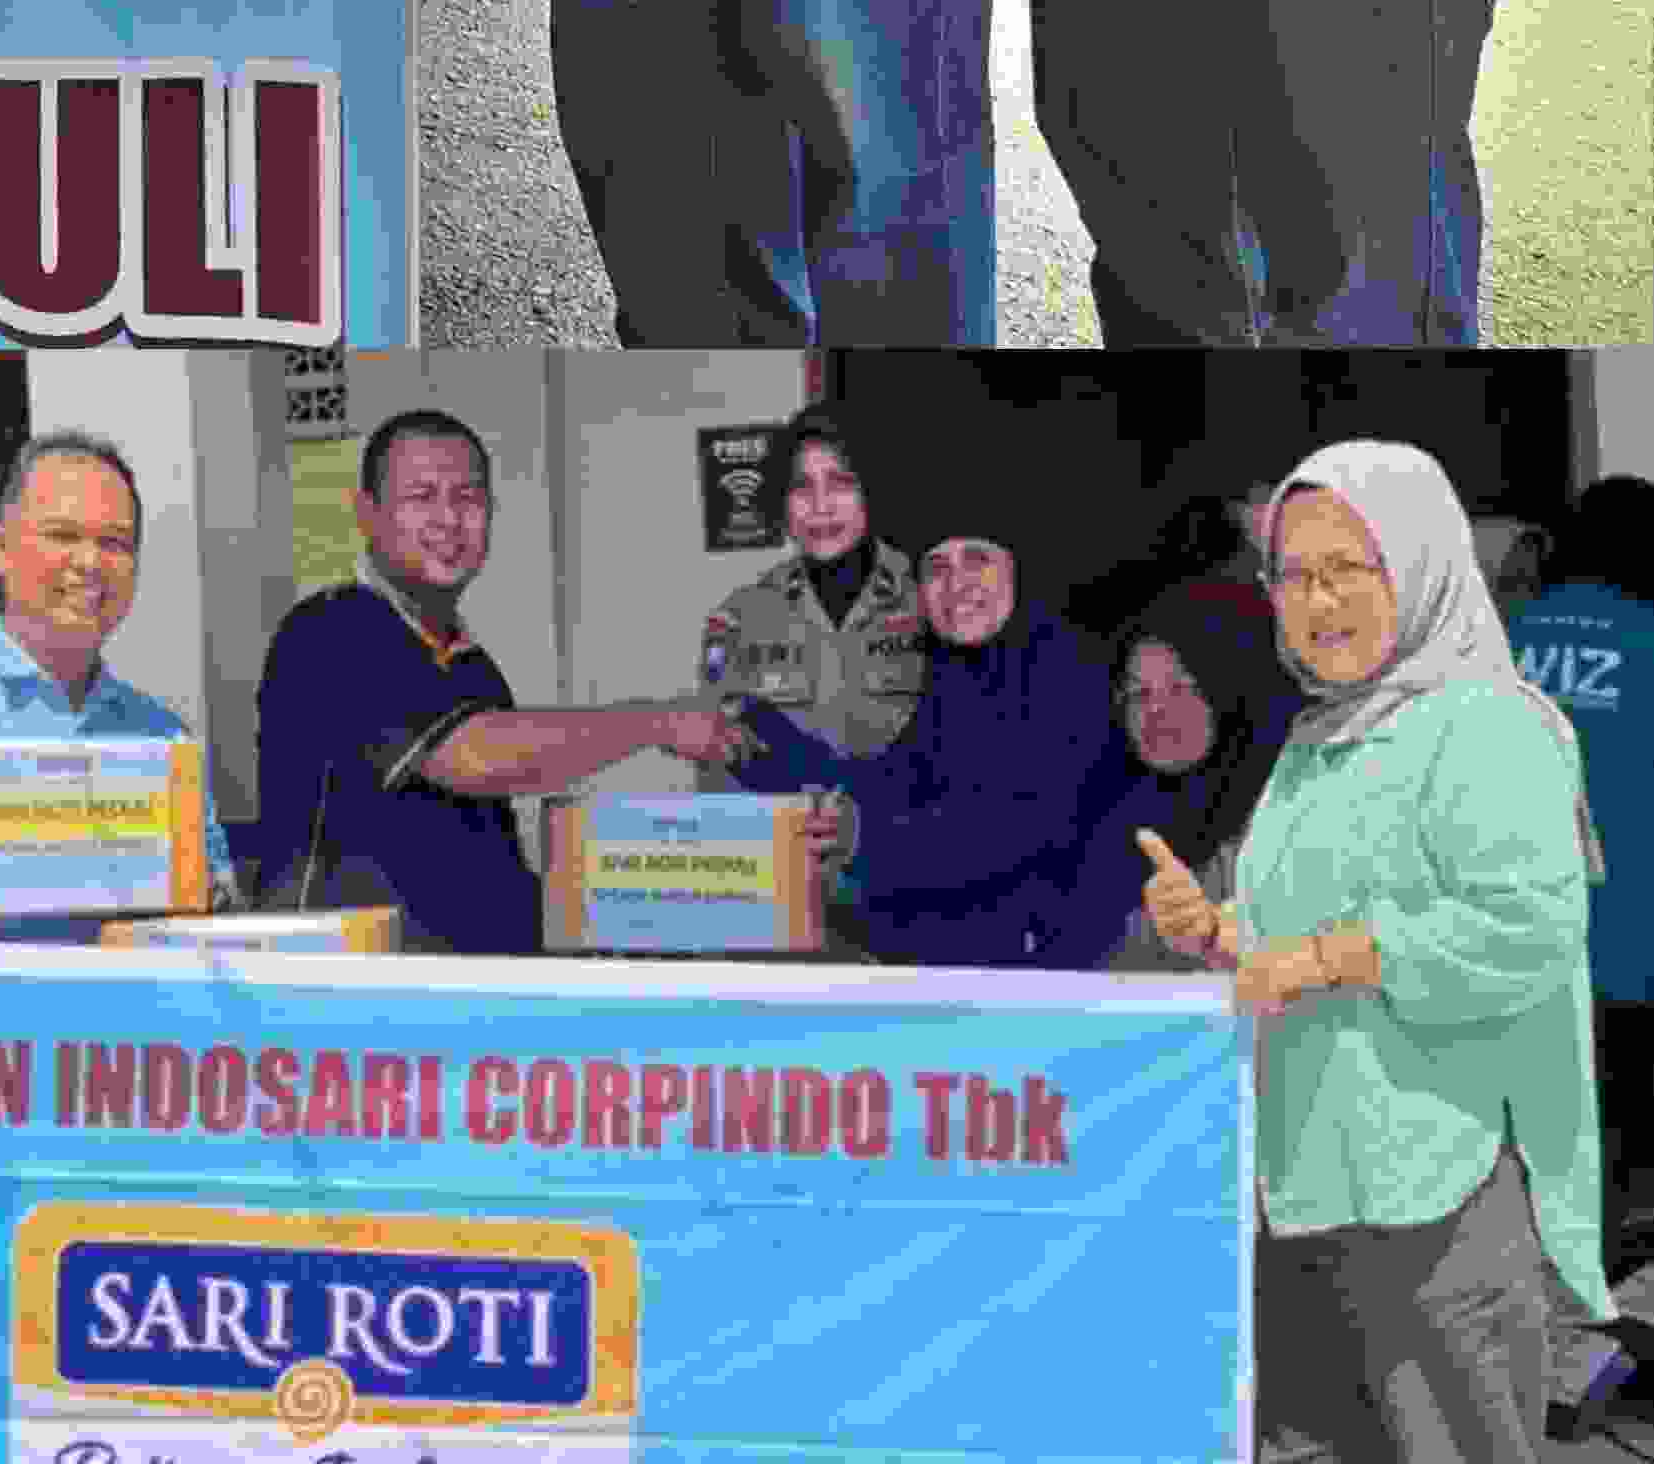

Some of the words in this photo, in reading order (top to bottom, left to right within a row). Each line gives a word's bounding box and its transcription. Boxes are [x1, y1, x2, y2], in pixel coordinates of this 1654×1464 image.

[53, 1041, 441, 1144] INDOSARI
[466, 1054, 890, 1163] CORPINDO
[913, 1069, 1072, 1168] Tbk
[86, 1272, 291, 1378] SARI
[331, 1282, 558, 1378] ROTI
